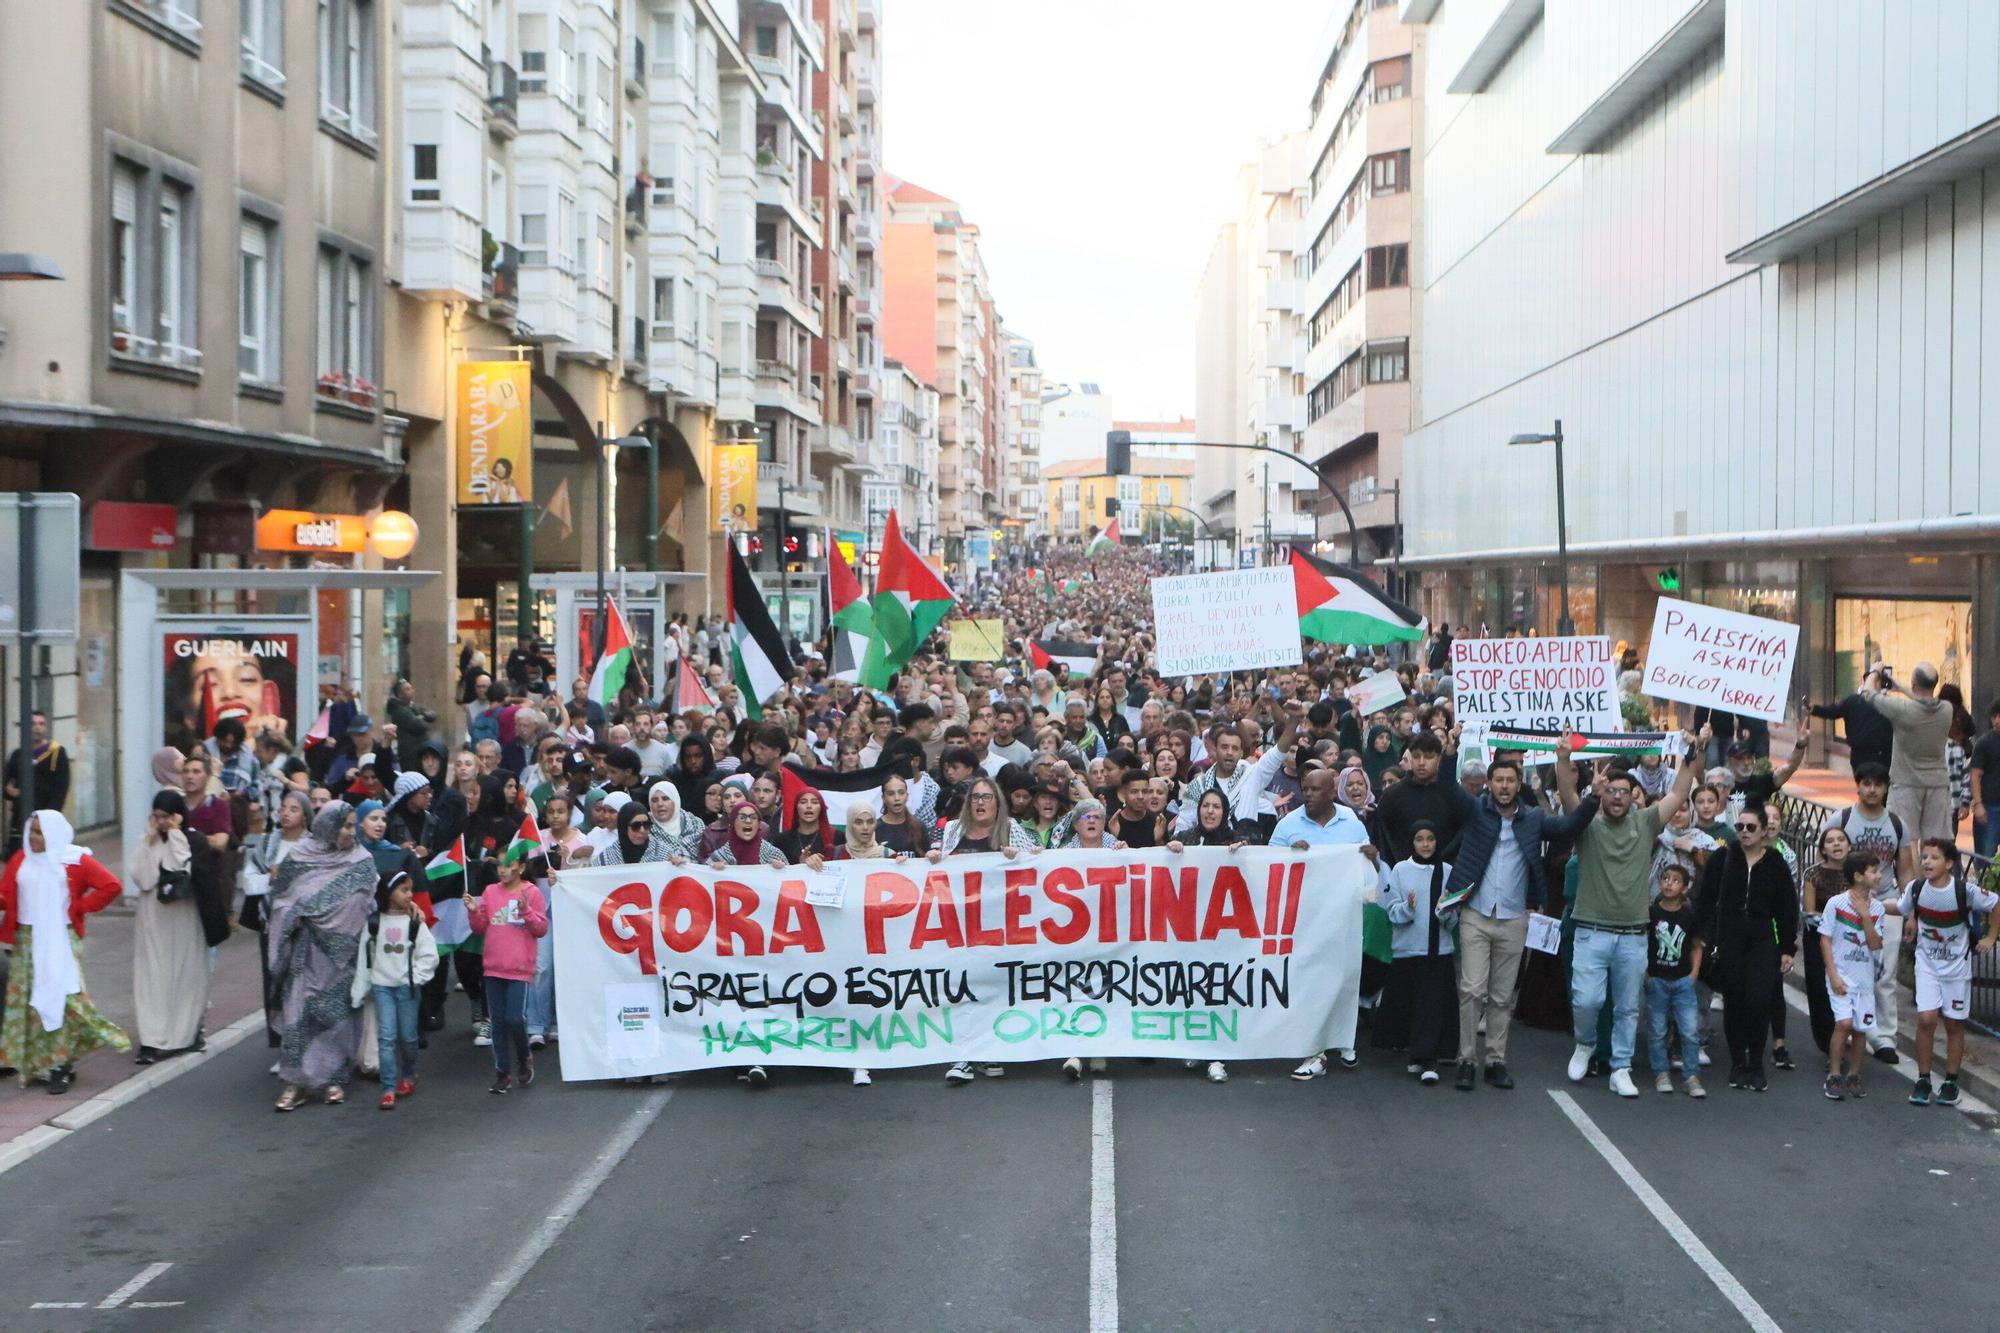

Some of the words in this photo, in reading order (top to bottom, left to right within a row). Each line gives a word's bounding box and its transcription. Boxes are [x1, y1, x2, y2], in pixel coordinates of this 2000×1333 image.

[469, 373, 489, 496] DENDARABA
[1275, 602, 1284, 616] A
[174, 639, 288, 658] GUERLAIN
[1457, 691, 1554, 714] PALESTINA
[1561, 690, 1609, 712] ASKE
[597, 875, 826, 976] GORA
[844, 966, 978, 1011] ESTATU
[699, 1006, 954, 1056] HARREMAN
[992, 1003, 1108, 1040] ORO
[1131, 1008, 1239, 1042] ETEN
